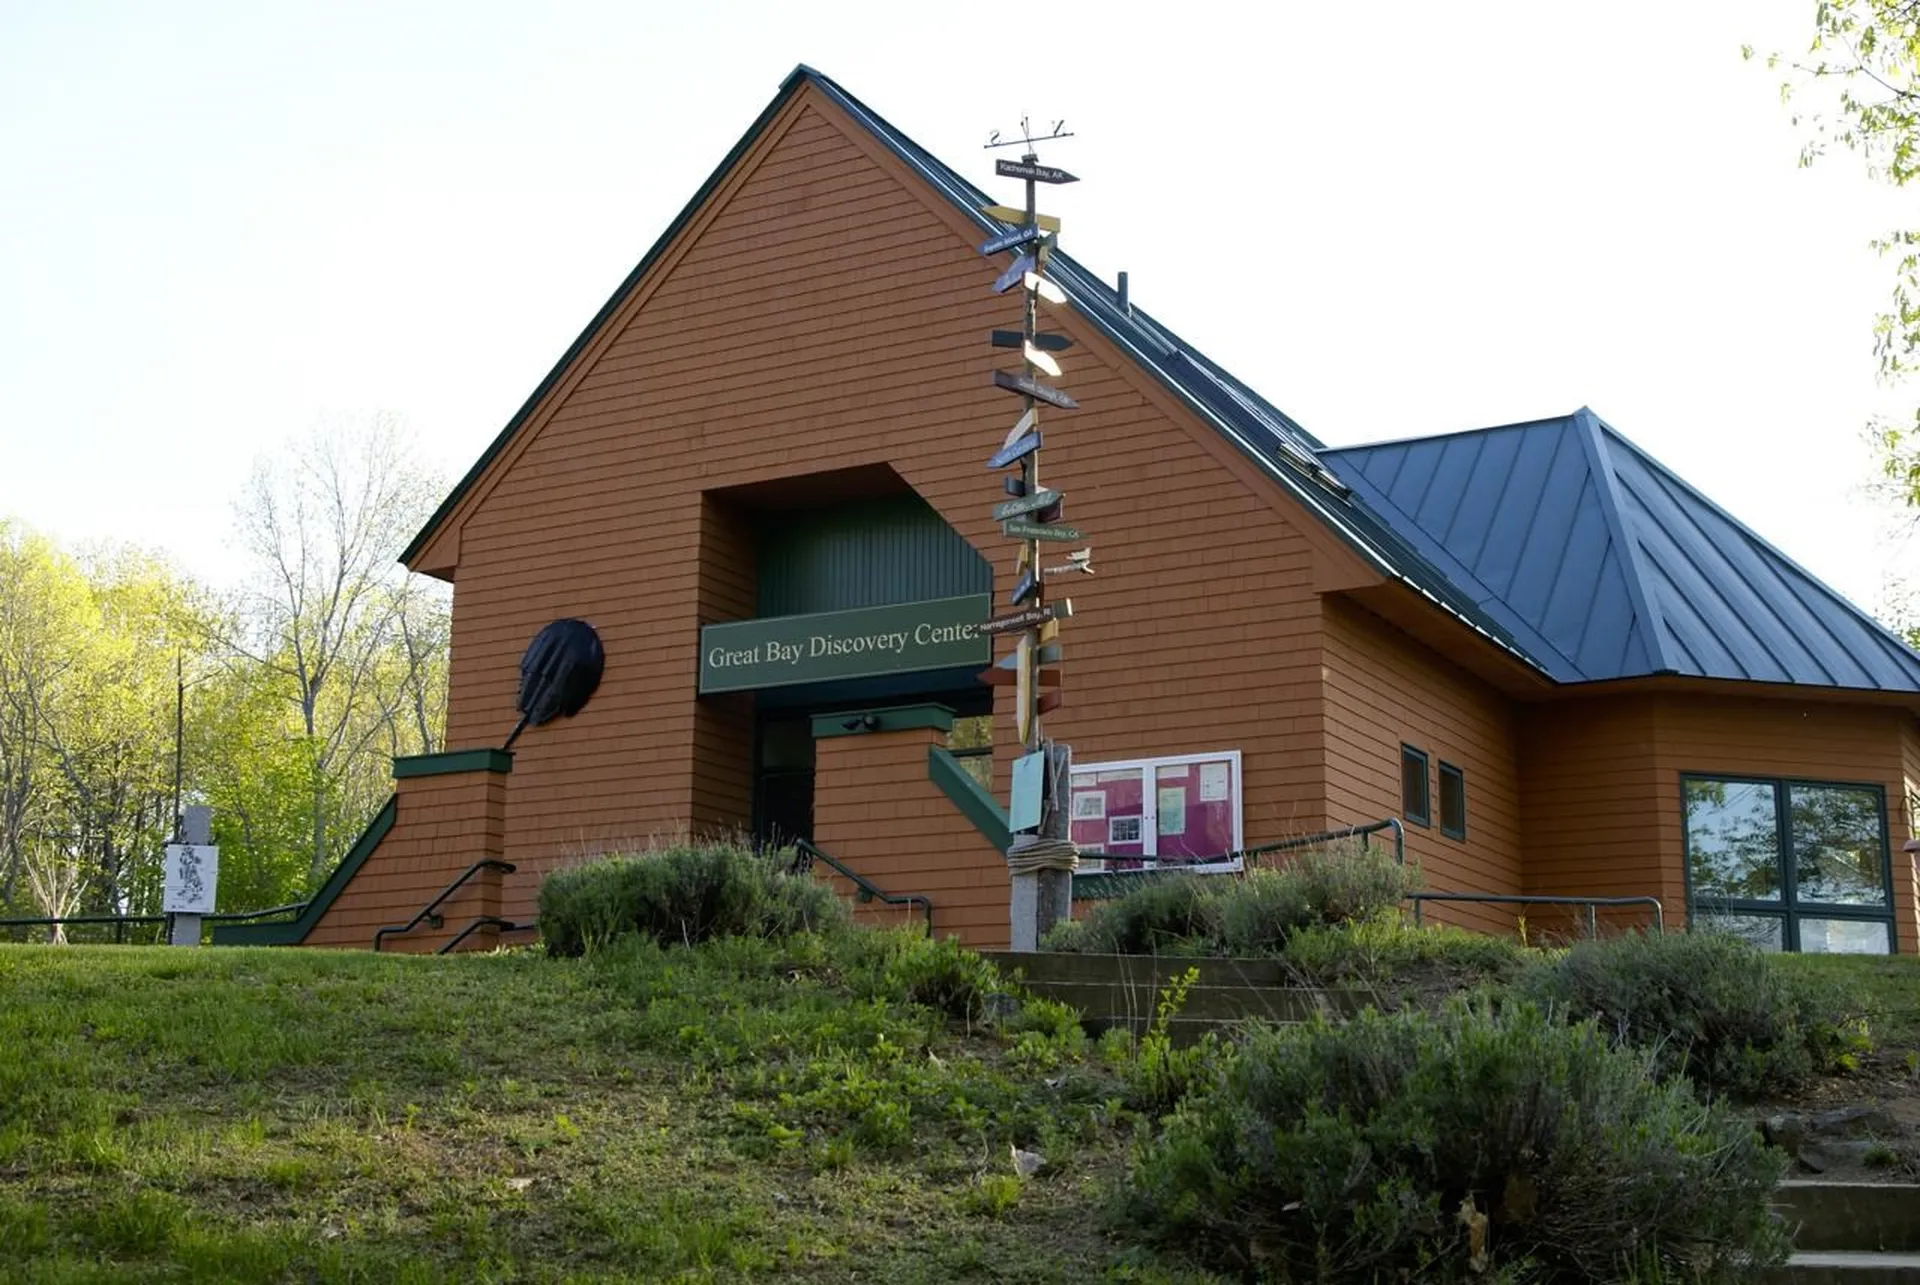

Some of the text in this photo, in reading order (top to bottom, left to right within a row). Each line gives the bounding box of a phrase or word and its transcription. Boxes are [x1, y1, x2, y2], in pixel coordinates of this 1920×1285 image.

[708, 645, 760, 668] Great
[766, 641, 804, 665] Bay
[810, 631, 909, 658] Discovery
